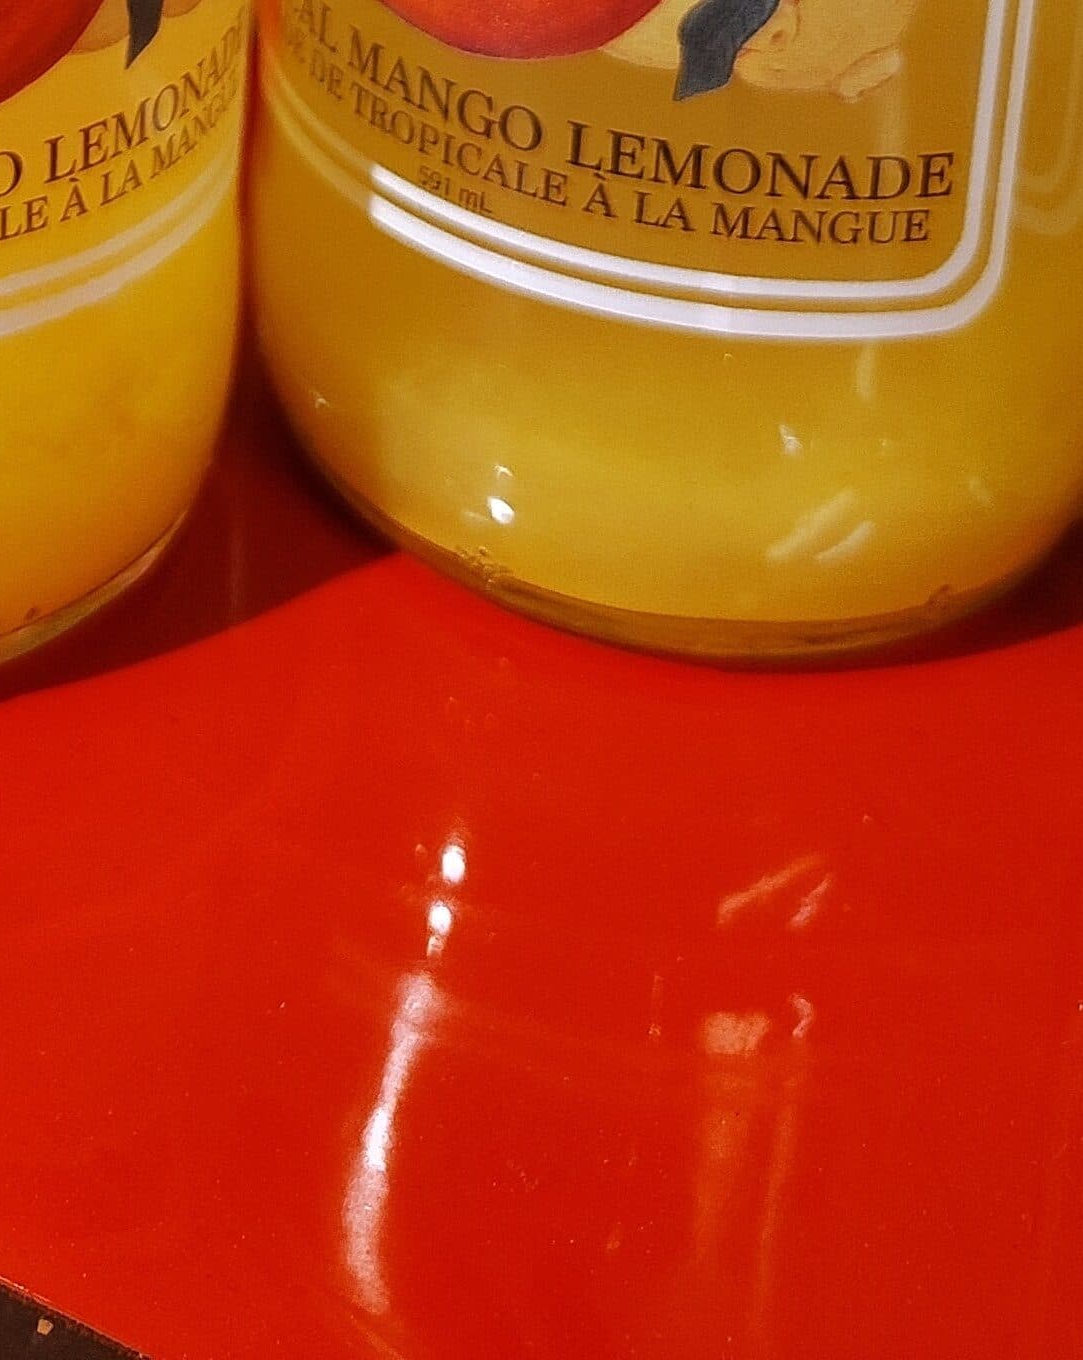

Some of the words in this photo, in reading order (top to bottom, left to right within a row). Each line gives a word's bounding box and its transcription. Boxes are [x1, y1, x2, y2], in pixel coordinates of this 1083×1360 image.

[60, 177, 89, 222] À
[99, 159, 143, 207] LA
[347, 24, 542, 152] MANGO
[566, 119, 955, 201] LEMONADE
[348, 80, 568, 207] TROPICALE
[582, 168, 619, 219] À
[633, 190, 697, 233] LA
[710, 201, 931, 245] MANGUE
